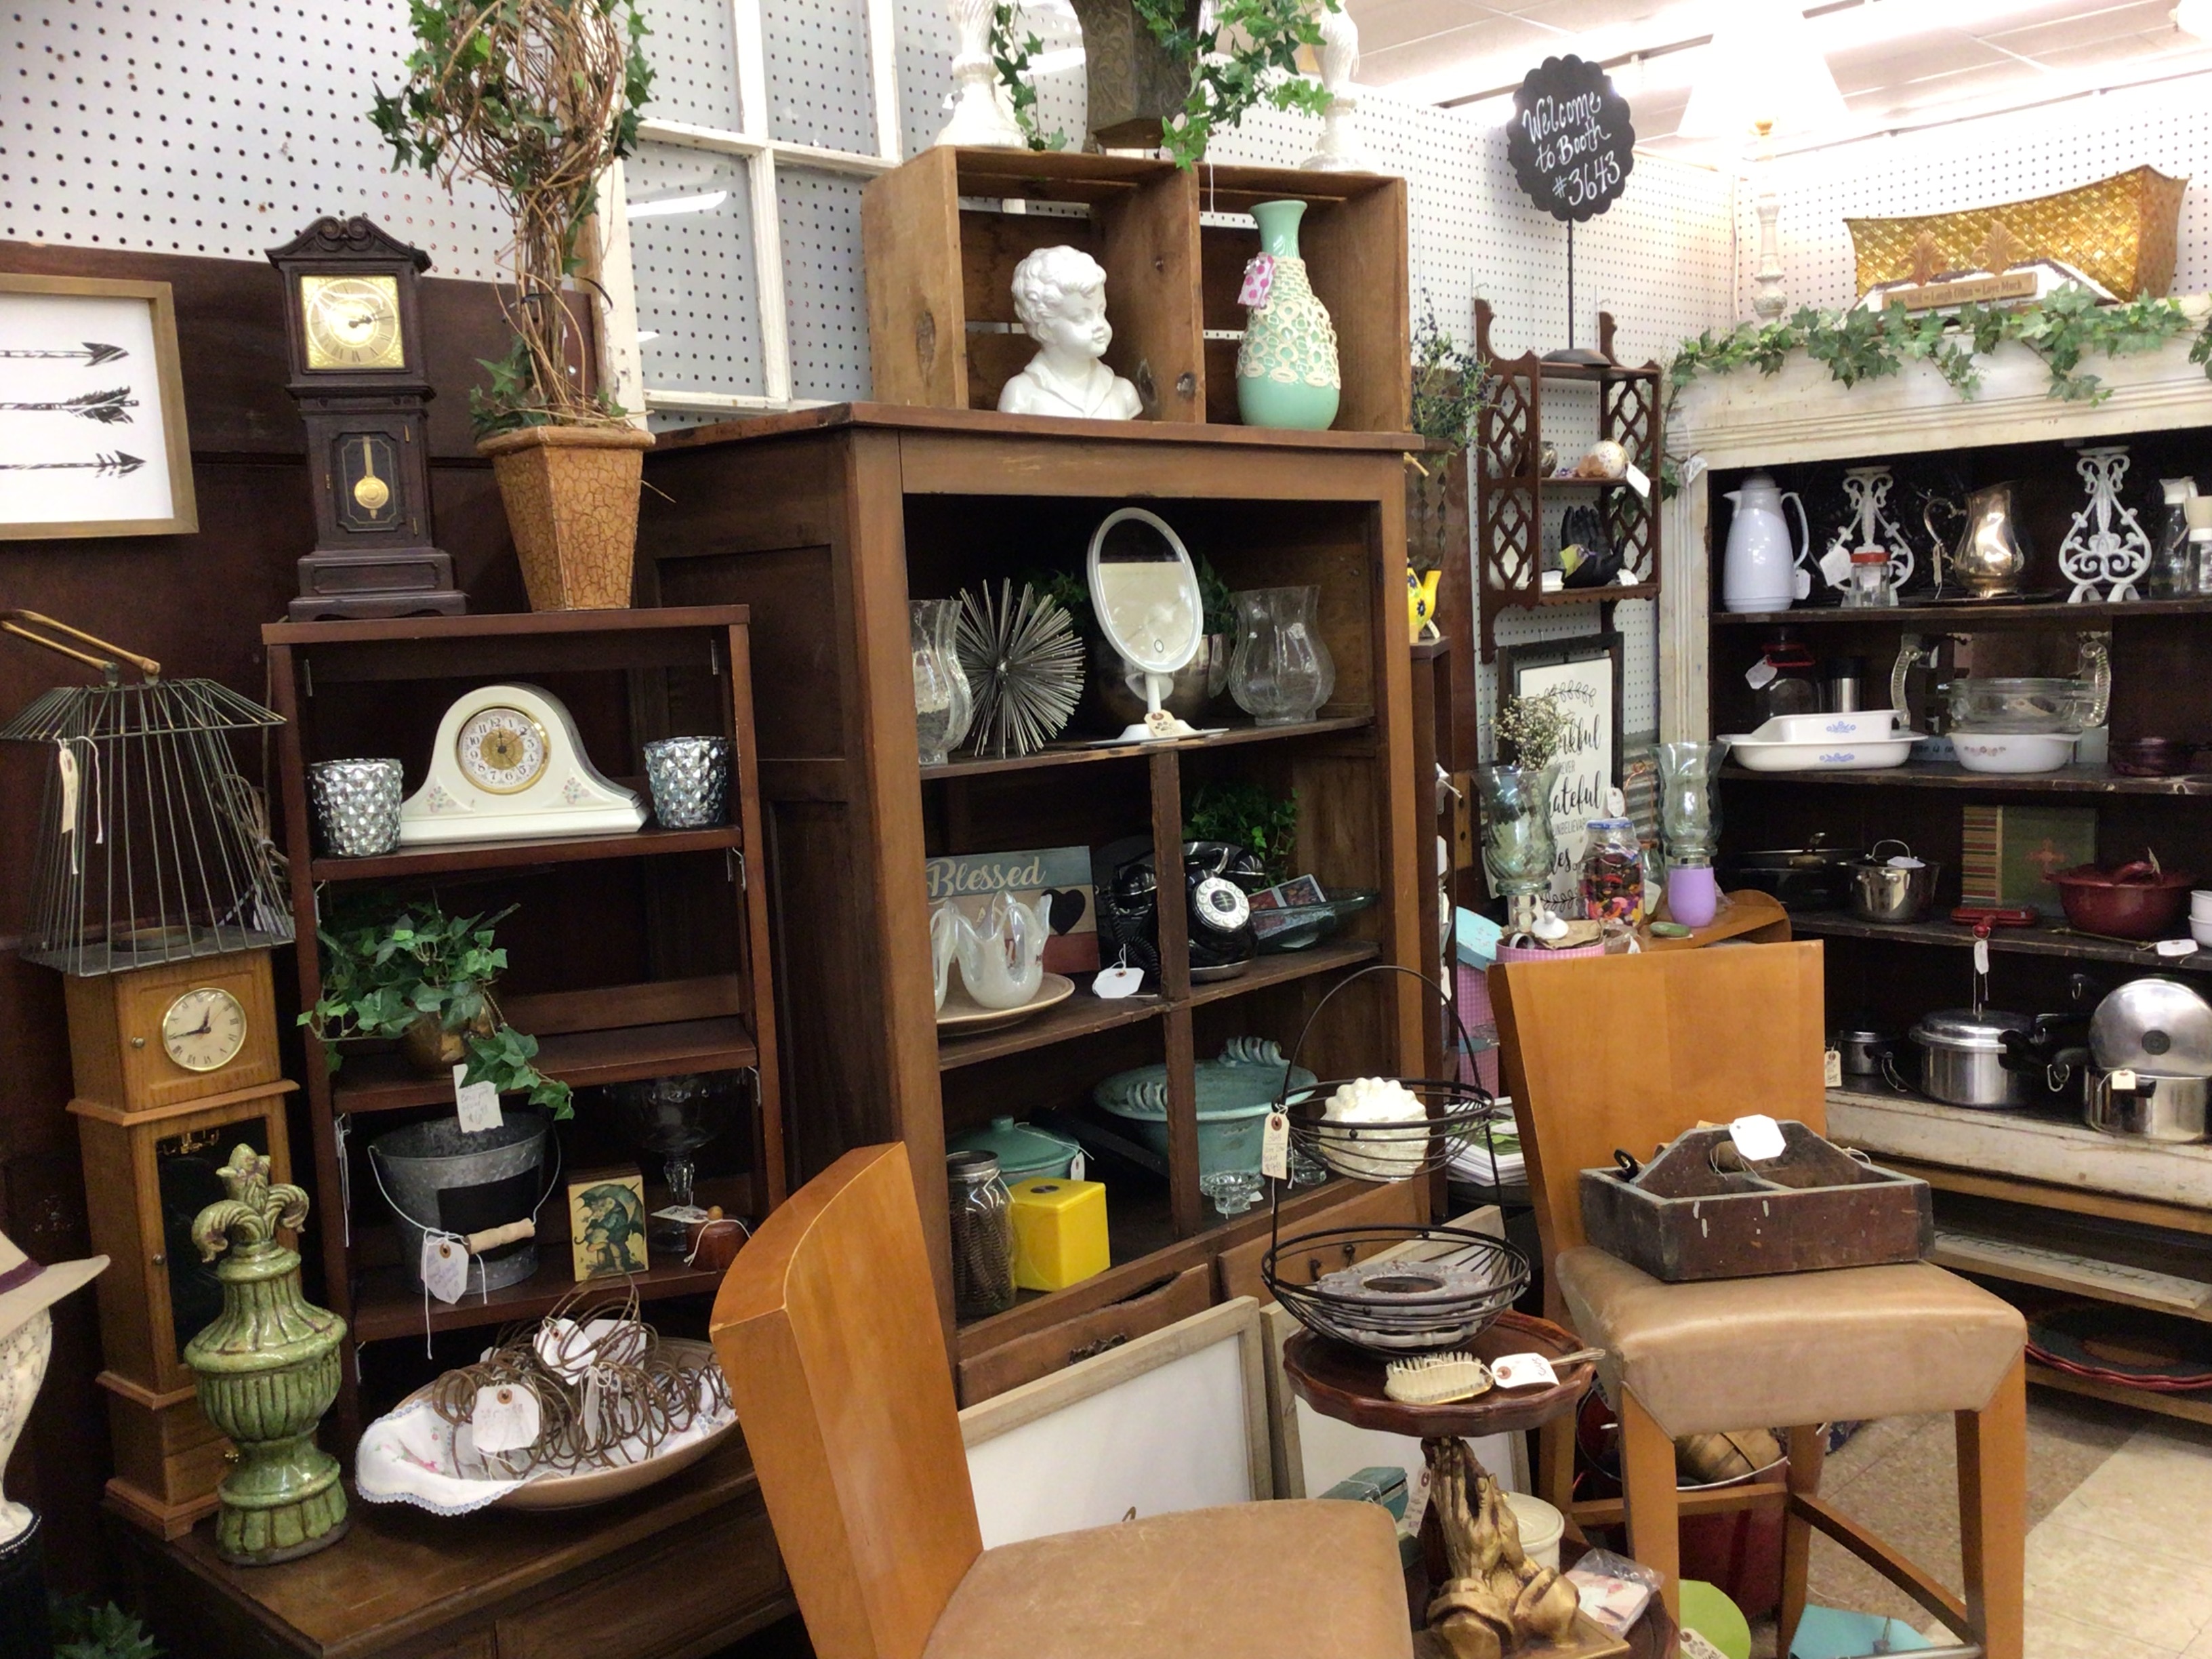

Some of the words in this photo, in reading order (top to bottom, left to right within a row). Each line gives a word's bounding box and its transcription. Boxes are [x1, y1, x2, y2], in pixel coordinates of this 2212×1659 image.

[1522, 91, 1601, 144] Welcome
[1535, 144, 1556, 173] to
[1557, 116, 1612, 165] Booth
[1552, 150, 1620, 206] #3643
[2001, 279, 2023, 293] Much
[926, 856, 1046, 904] Blessed
